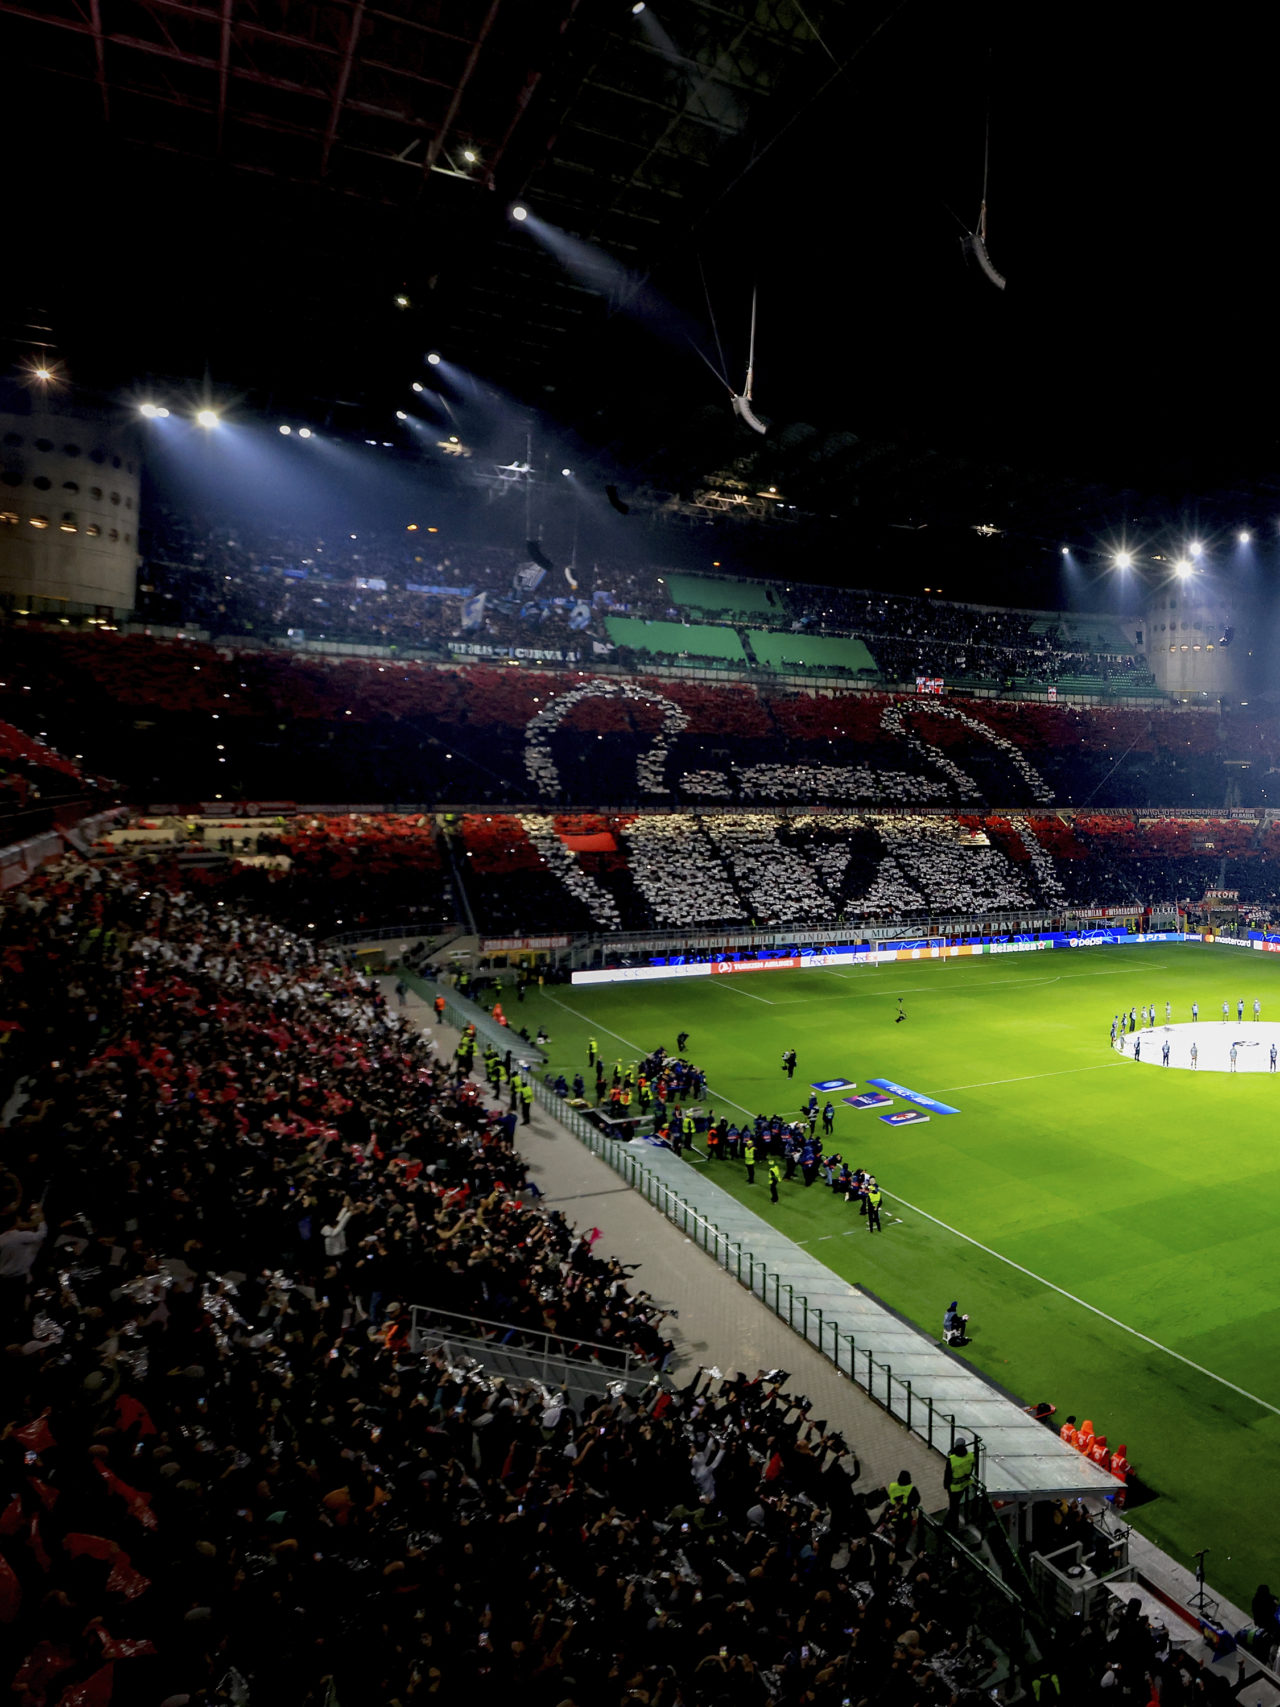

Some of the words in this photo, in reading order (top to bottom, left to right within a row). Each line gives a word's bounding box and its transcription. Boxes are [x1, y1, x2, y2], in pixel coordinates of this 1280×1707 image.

[514, 647, 563, 661] CURVA
[686, 806, 782, 815] ASSOCIAZIONE
[842, 806, 878, 815] MILAN
[880, 807, 911, 815] CLUB
[1206, 891, 1239, 899] ARCORE
[939, 924, 984, 934] FAMILY
[991, 922, 1013, 931] DAY
[1019, 919, 1051, 930] AIMC
[792, 930, 866, 943] FONDAZIONE
[871, 928, 906, 938] MILAN
[1146, 933, 1167, 941] PS5
[1078, 937, 1103, 947] pepsi
[1215, 936, 1251, 947] mastercard
[989, 941, 1038, 953] Heineken
